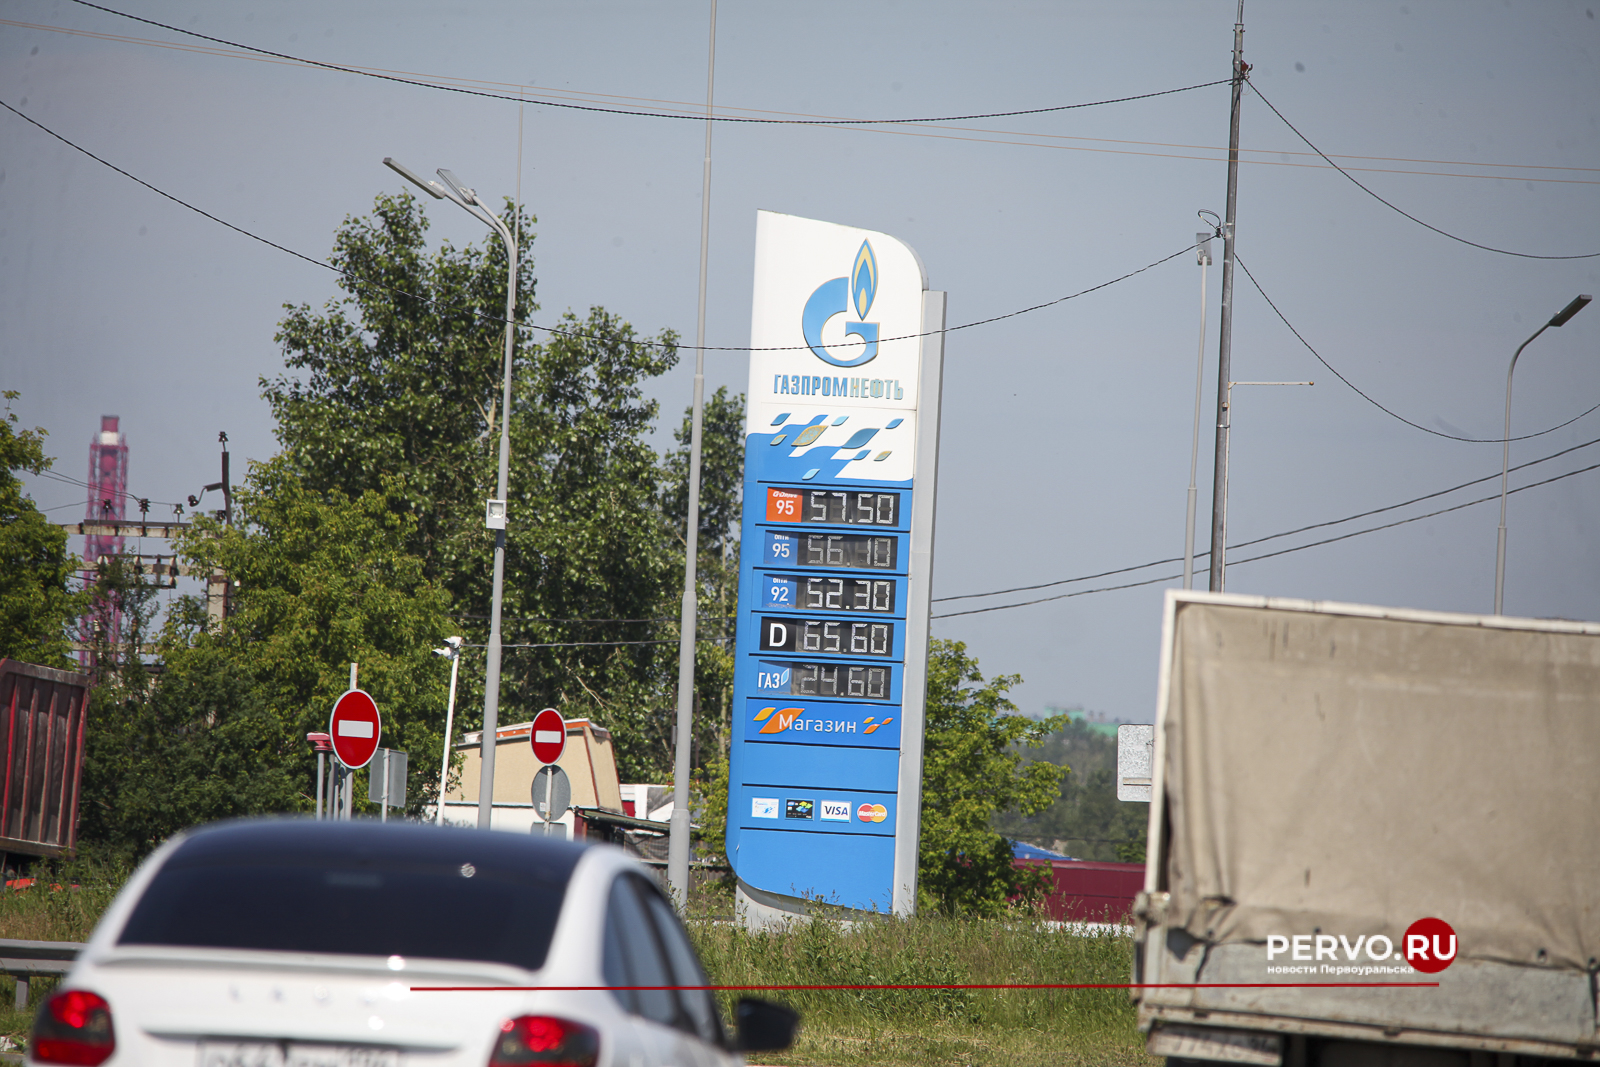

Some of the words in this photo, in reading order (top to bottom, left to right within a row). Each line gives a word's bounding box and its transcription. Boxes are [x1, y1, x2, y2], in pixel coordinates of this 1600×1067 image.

[773, 374, 904, 400] ГАЗПРОМНЕФТЬ
[776, 500, 794, 515] 95
[810, 491, 894, 524] 57.50
[772, 543, 790, 558] 95
[807, 535, 892, 567] 56.10
[770, 586, 789, 602] 92
[806, 577, 891, 611] 52.30
[769, 622, 787, 647] D
[803, 620, 889, 654] 65.60
[758, 672, 781, 689] ГАЗ
[800, 664, 886, 698] 24.60
[779, 713, 857, 733] Магазин
[824, 805, 849, 816] VISA
[858, 809, 886, 818] MasterCard
